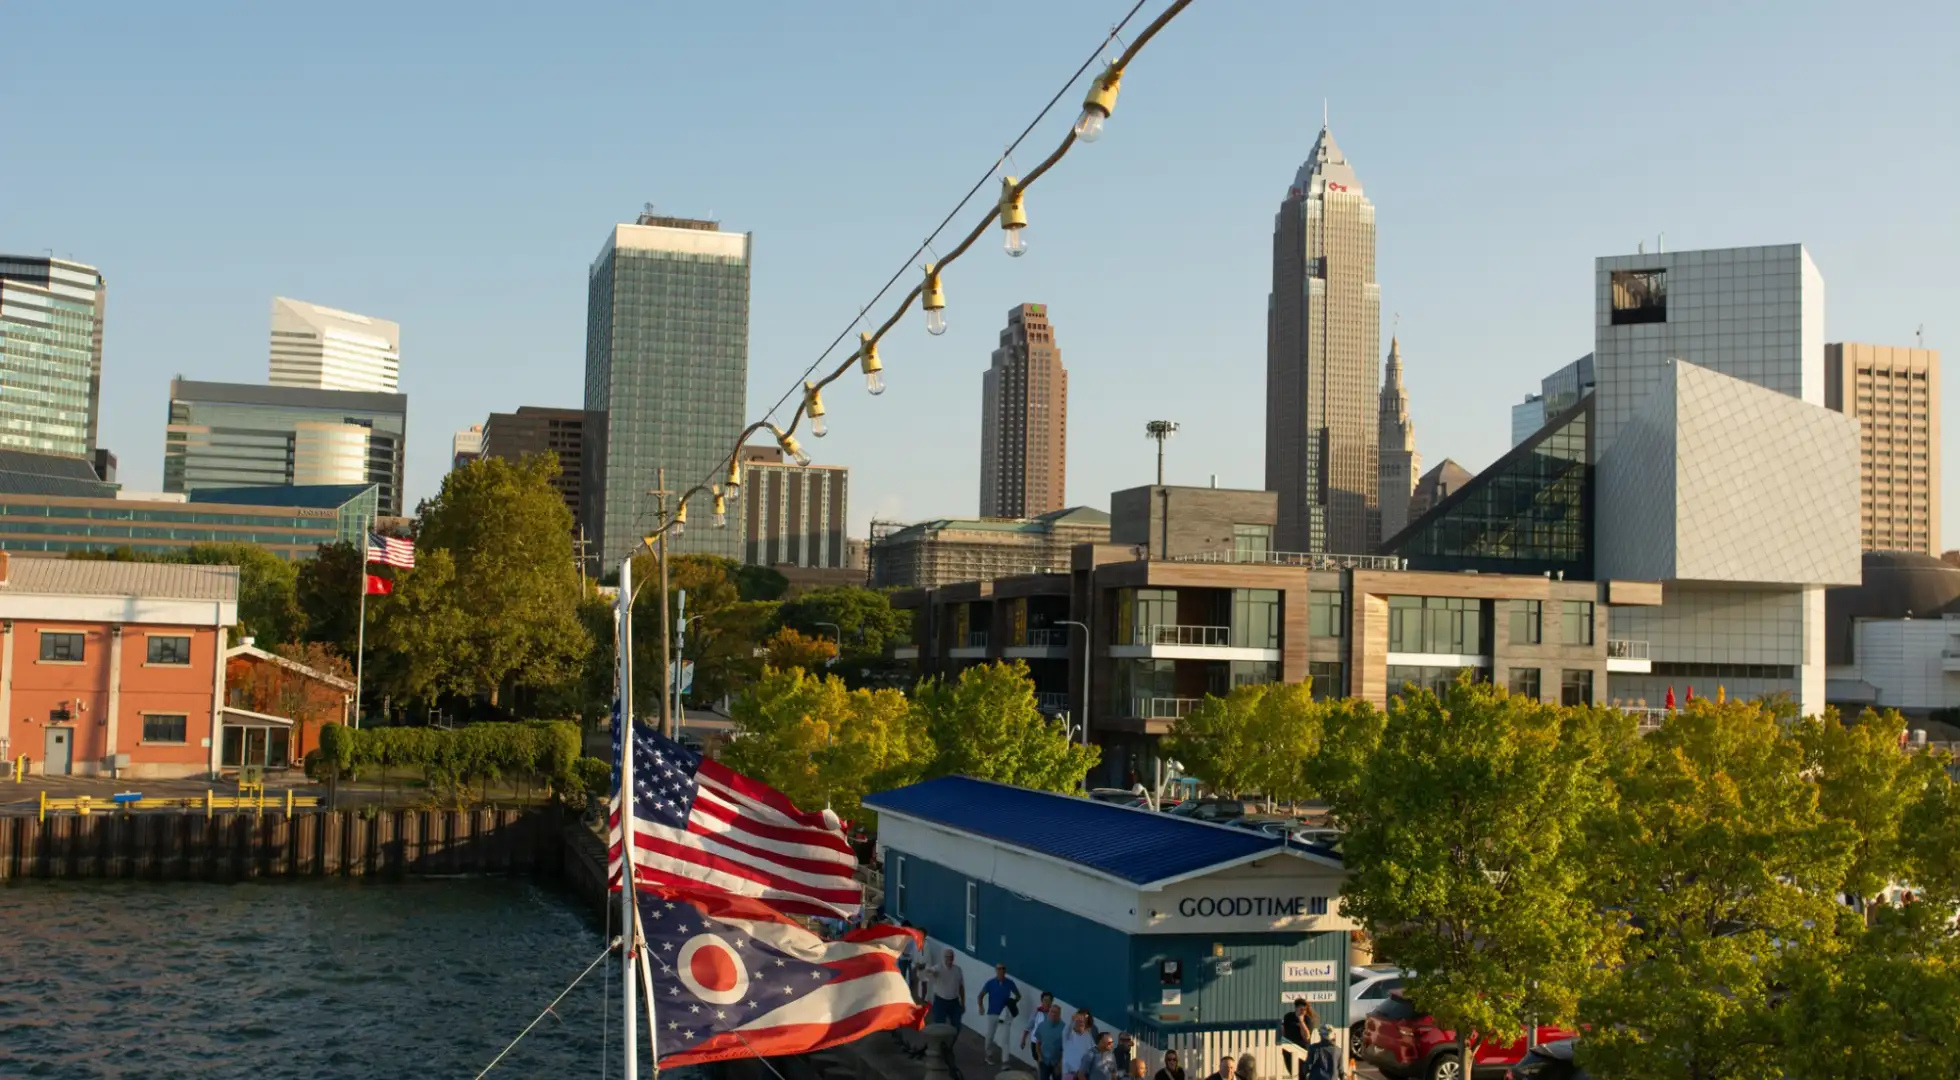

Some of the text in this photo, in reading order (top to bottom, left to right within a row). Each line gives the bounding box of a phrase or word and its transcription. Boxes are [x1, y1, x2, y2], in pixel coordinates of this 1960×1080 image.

[1179, 896, 1328, 917] GOODTIME III
[1288, 966, 1323, 977] Tickets
